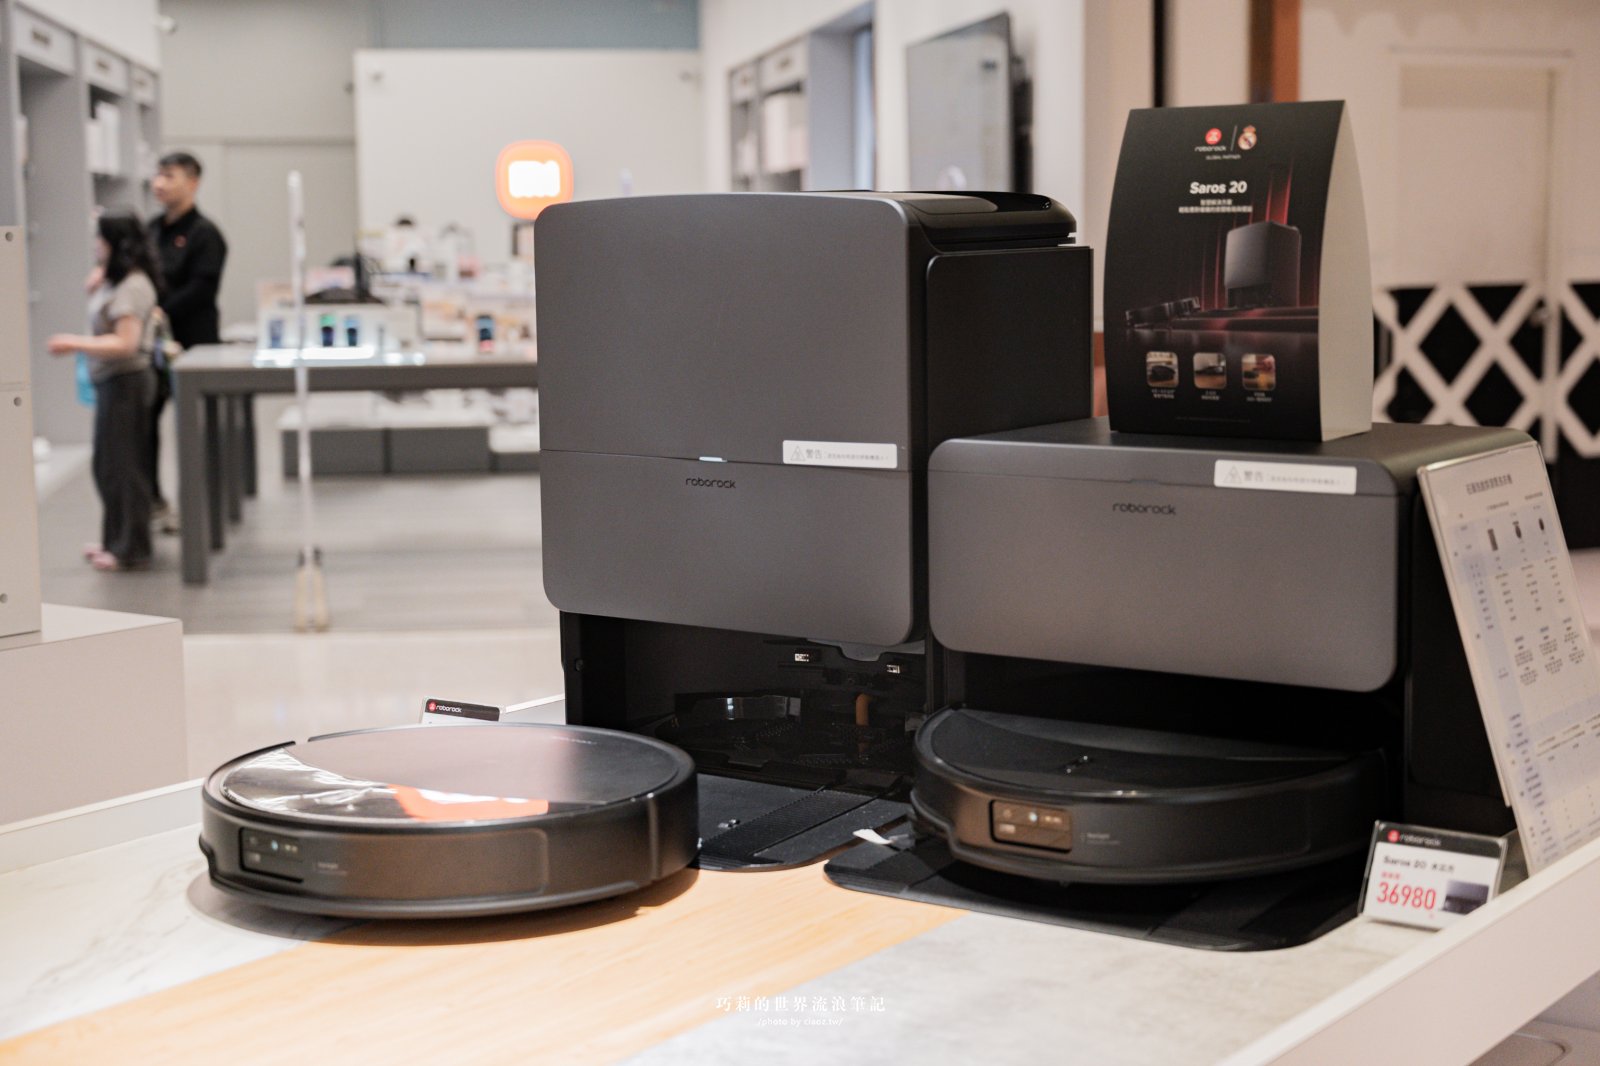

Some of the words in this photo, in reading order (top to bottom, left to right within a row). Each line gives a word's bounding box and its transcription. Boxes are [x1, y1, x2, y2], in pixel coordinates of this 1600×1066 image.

[1189, 181, 1227, 194] Saros
[1228, 180, 1248, 194] 20
[685, 477, 736, 489] roborock
[1112, 502, 1176, 515] roborock
[436, 704, 462, 713] roborock
[1376, 882, 1437, 910] 36980
